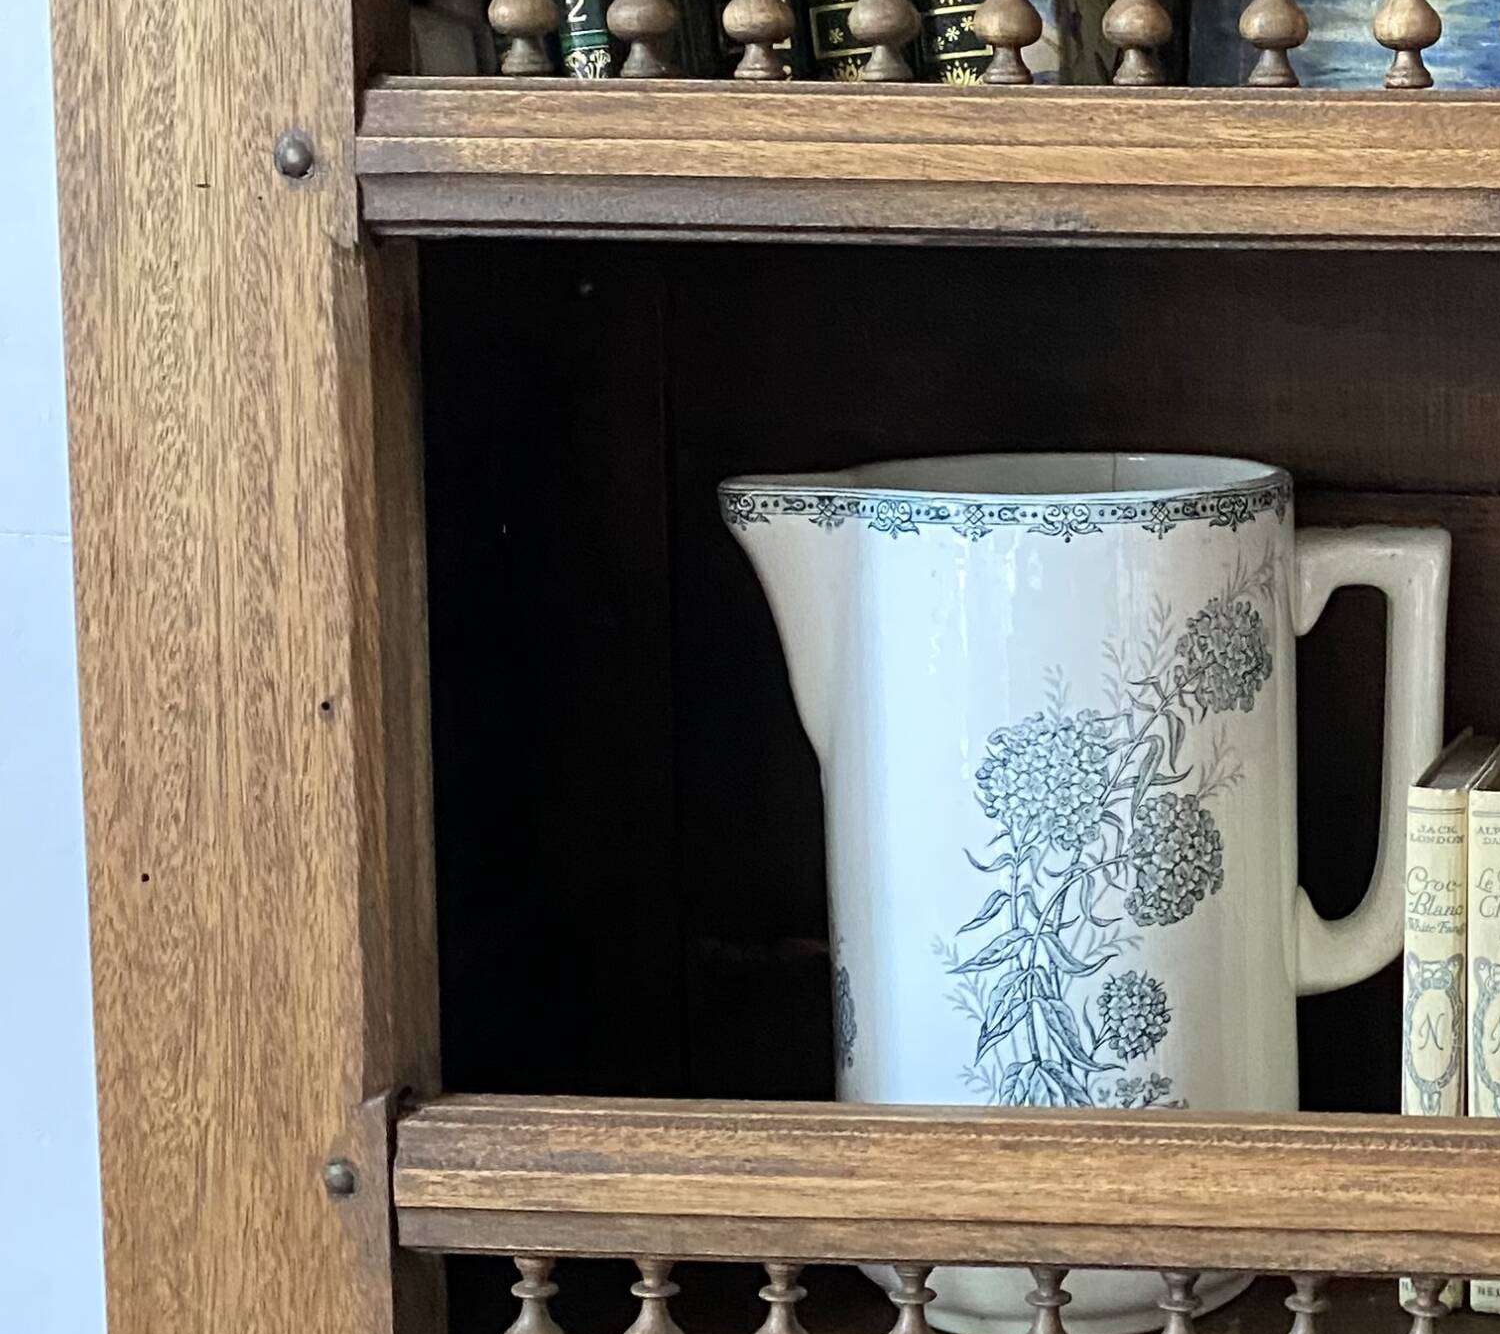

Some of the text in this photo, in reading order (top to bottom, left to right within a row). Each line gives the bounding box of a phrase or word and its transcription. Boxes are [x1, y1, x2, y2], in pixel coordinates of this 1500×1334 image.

[1417, 825, 1458, 834] JACK
[1410, 834, 1465, 845] LONDON
[1475, 867, 1494, 893] Le
[1417, 1012, 1446, 1051] N
